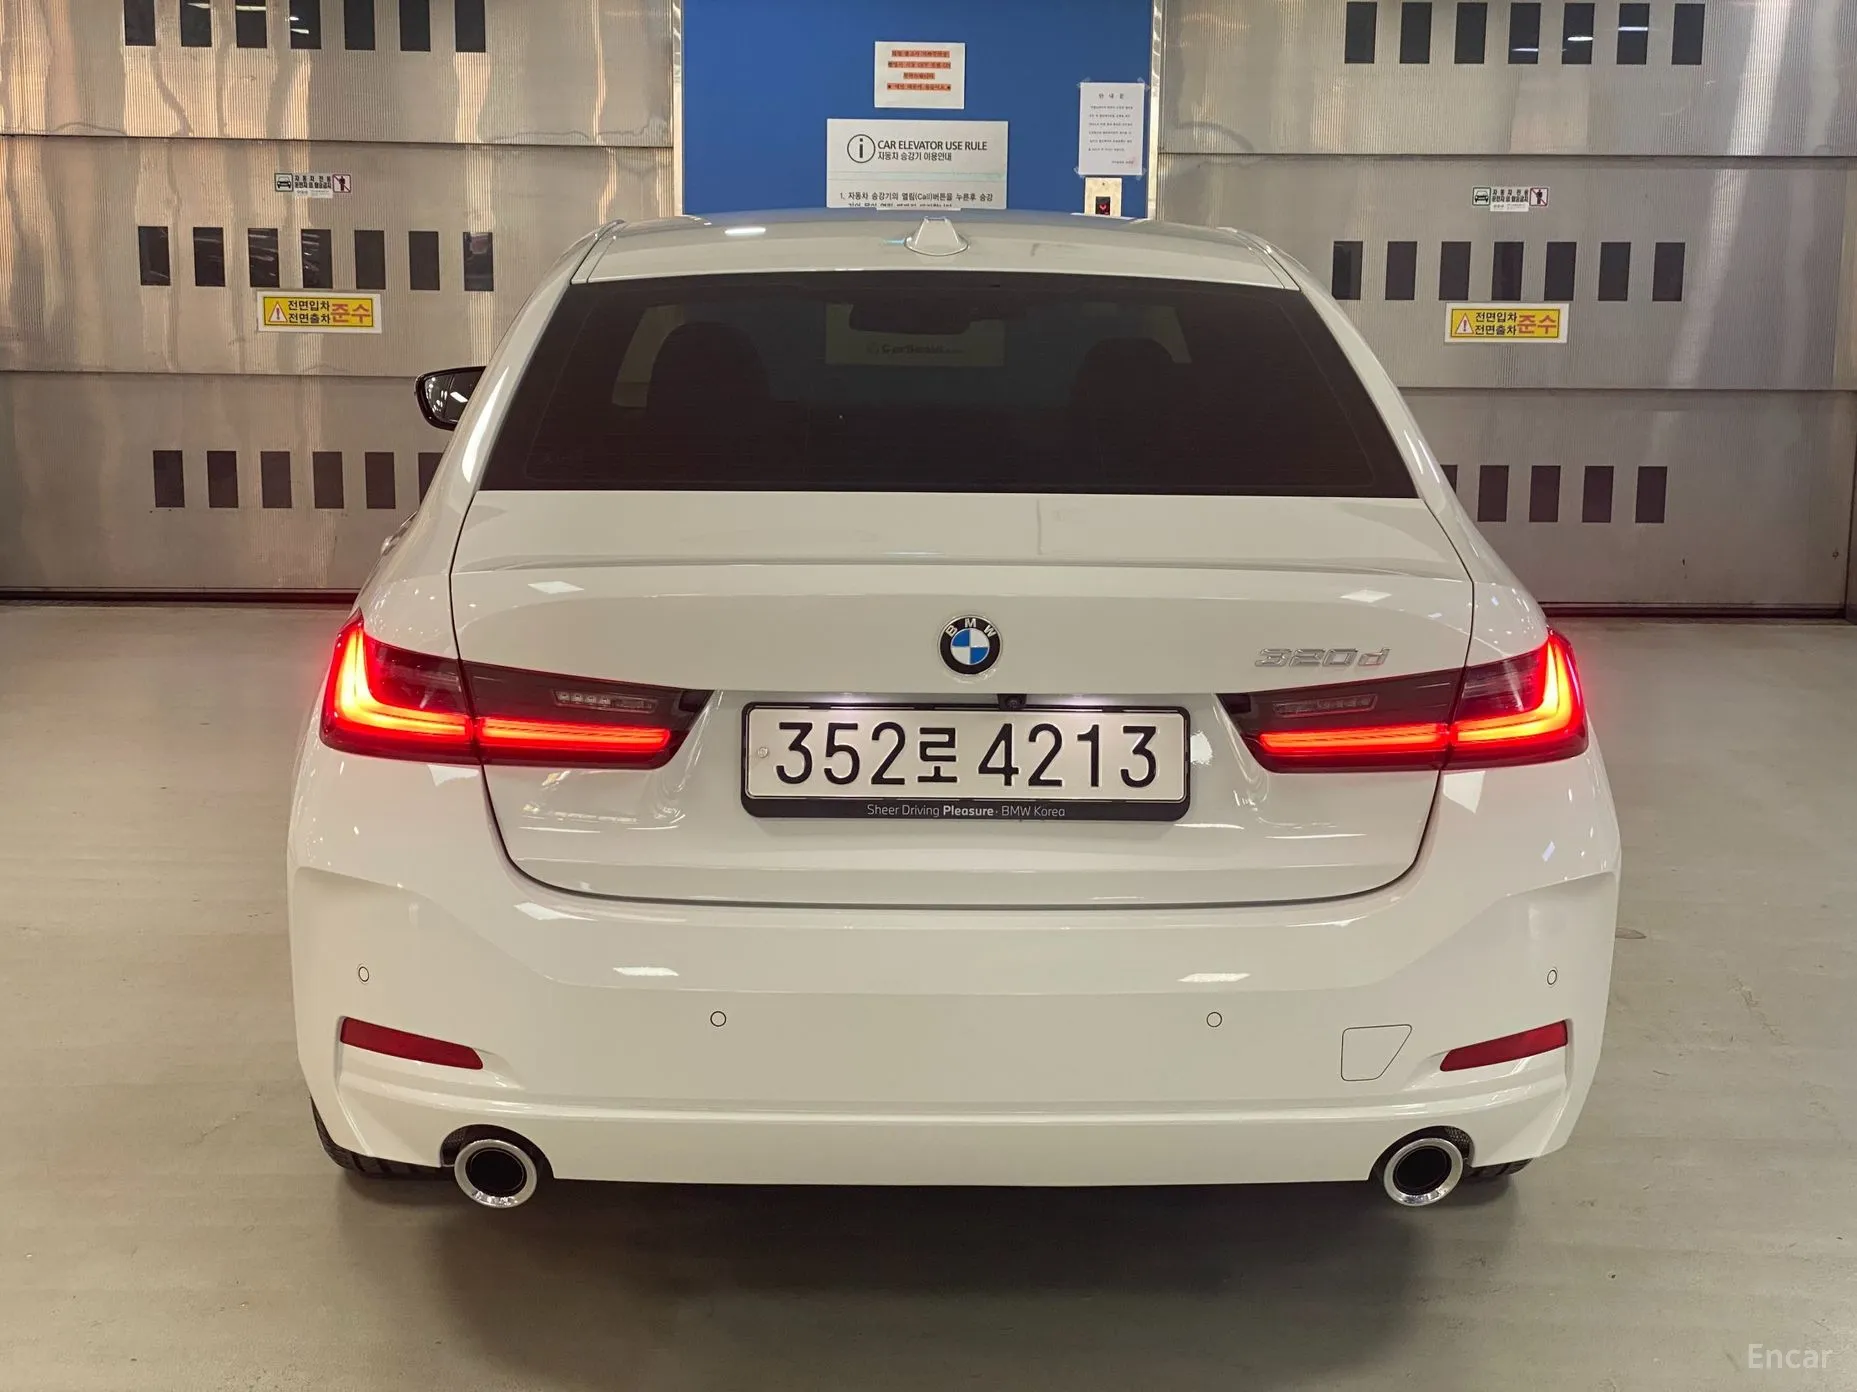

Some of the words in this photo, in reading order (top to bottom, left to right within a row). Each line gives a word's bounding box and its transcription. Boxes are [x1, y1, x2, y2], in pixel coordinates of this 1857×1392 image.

[877, 140, 896, 150] CAR
[898, 141, 943, 151] ELEVATOR
[945, 141, 963, 151] USE
[964, 141, 988, 151] RULE
[877, 151, 899, 161] 자동차
[900, 151, 922, 161] 승강기
[923, 152, 953, 162] 이용안내
[848, 192, 869, 200] 자동차
[871, 192, 898, 200] 승강기의
[979, 193, 993, 201] 승강
[288, 300, 330, 312] 전면입차
[288, 312, 331, 324] 전면출차
[331, 303, 371, 323] 준수
[1475, 312, 1517, 323] 전면입차
[1474, 324, 1517, 336] 전면출차
[1517, 314, 1557, 335] 준수
[945, 618, 997, 637] BMW
[1254, 648, 1392, 667] 320d
[775, 721, 958, 786] 352로
[978, 723, 1160, 789] 4213
[867, 804, 899, 816] Sheer
[901, 805, 940, 818] Driving
[1001, 806, 1031, 817] BMW
[1034, 806, 1066, 817] Korea
